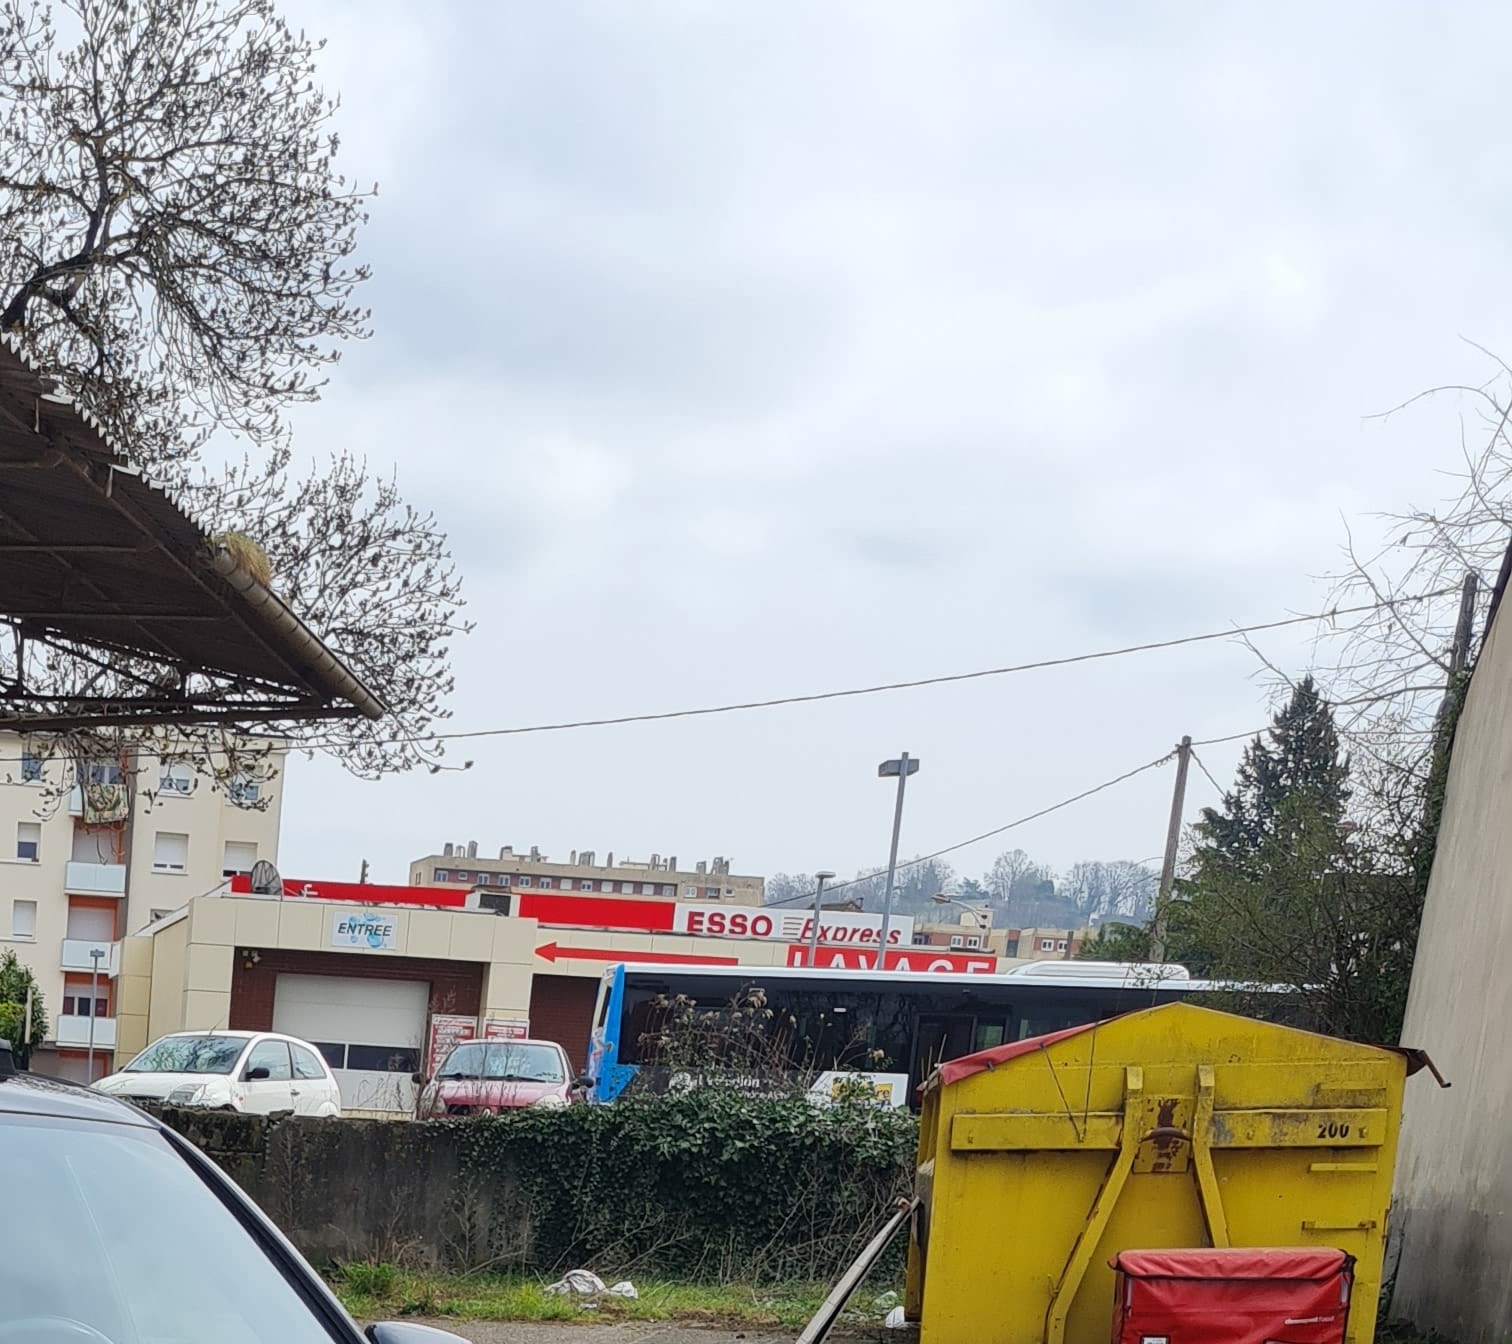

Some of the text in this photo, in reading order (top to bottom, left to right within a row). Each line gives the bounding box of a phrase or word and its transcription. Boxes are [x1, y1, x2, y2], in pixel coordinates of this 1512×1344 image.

[338, 922, 392, 937] ENTREE
[687, 911, 901, 945] ESSO Express
[1317, 1123, 1350, 1139] 200
